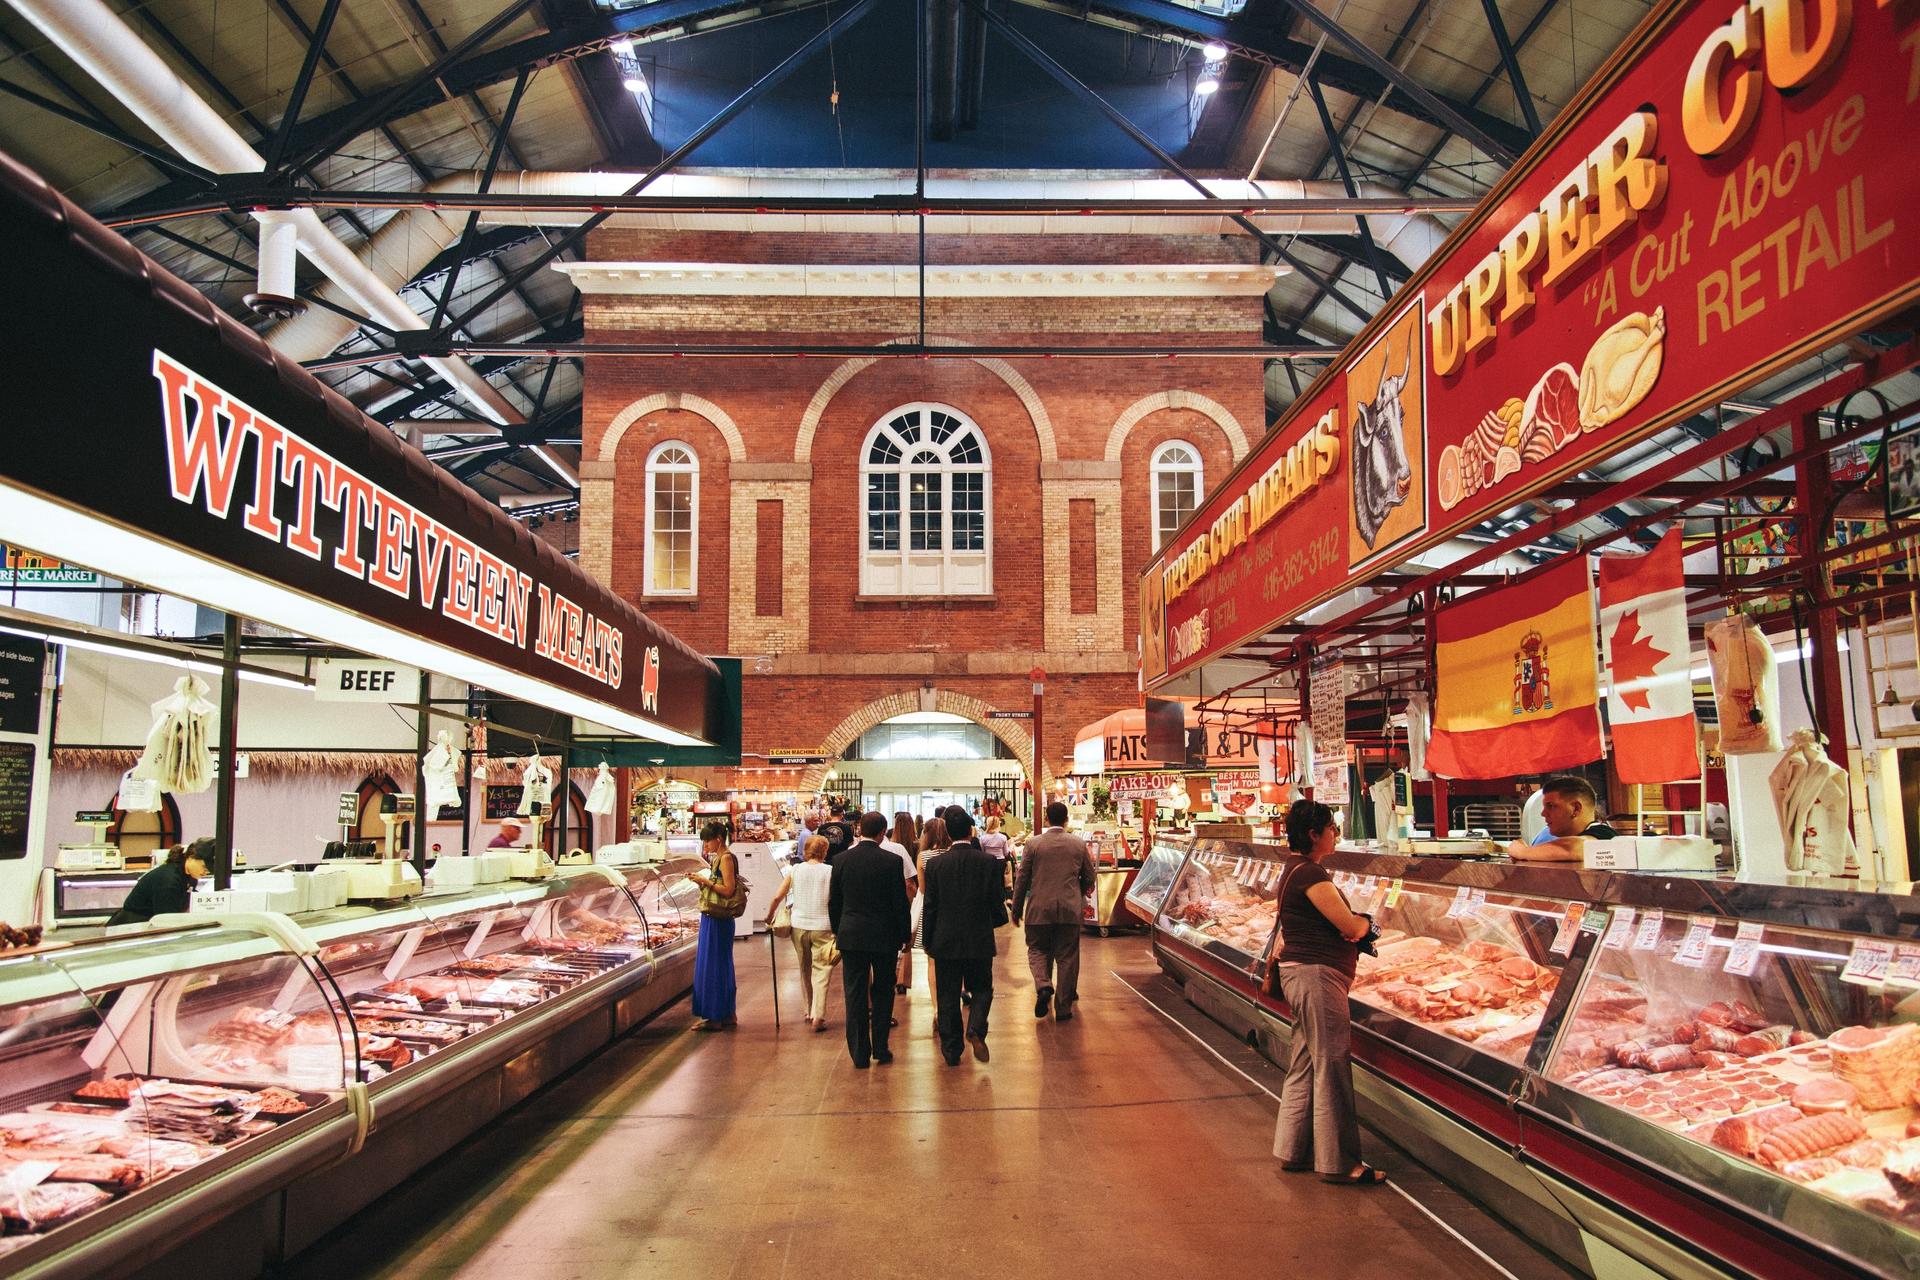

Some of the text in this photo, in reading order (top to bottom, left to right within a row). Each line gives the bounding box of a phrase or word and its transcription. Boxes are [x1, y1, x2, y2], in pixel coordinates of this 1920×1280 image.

[1428, 0, 1905, 377] UPPER CU
[1630, 210, 1693, 299] Cut
[1709, 94, 1864, 247] Above
[1698, 175, 1894, 346] RETAIL
[153, 347, 623, 689] WITTEVEEN MEATS
[1163, 408, 1341, 604] UPPER CUT MEATS
[43, 571, 93, 581] MARKET
[1262, 526, 1340, 602] 416-362-3142
[1213, 596, 1238, 632] RETAIL
[19, 653, 35, 663] bacon
[340, 669, 395, 692] BEEF
[1219, 772, 1238, 780] BEST
